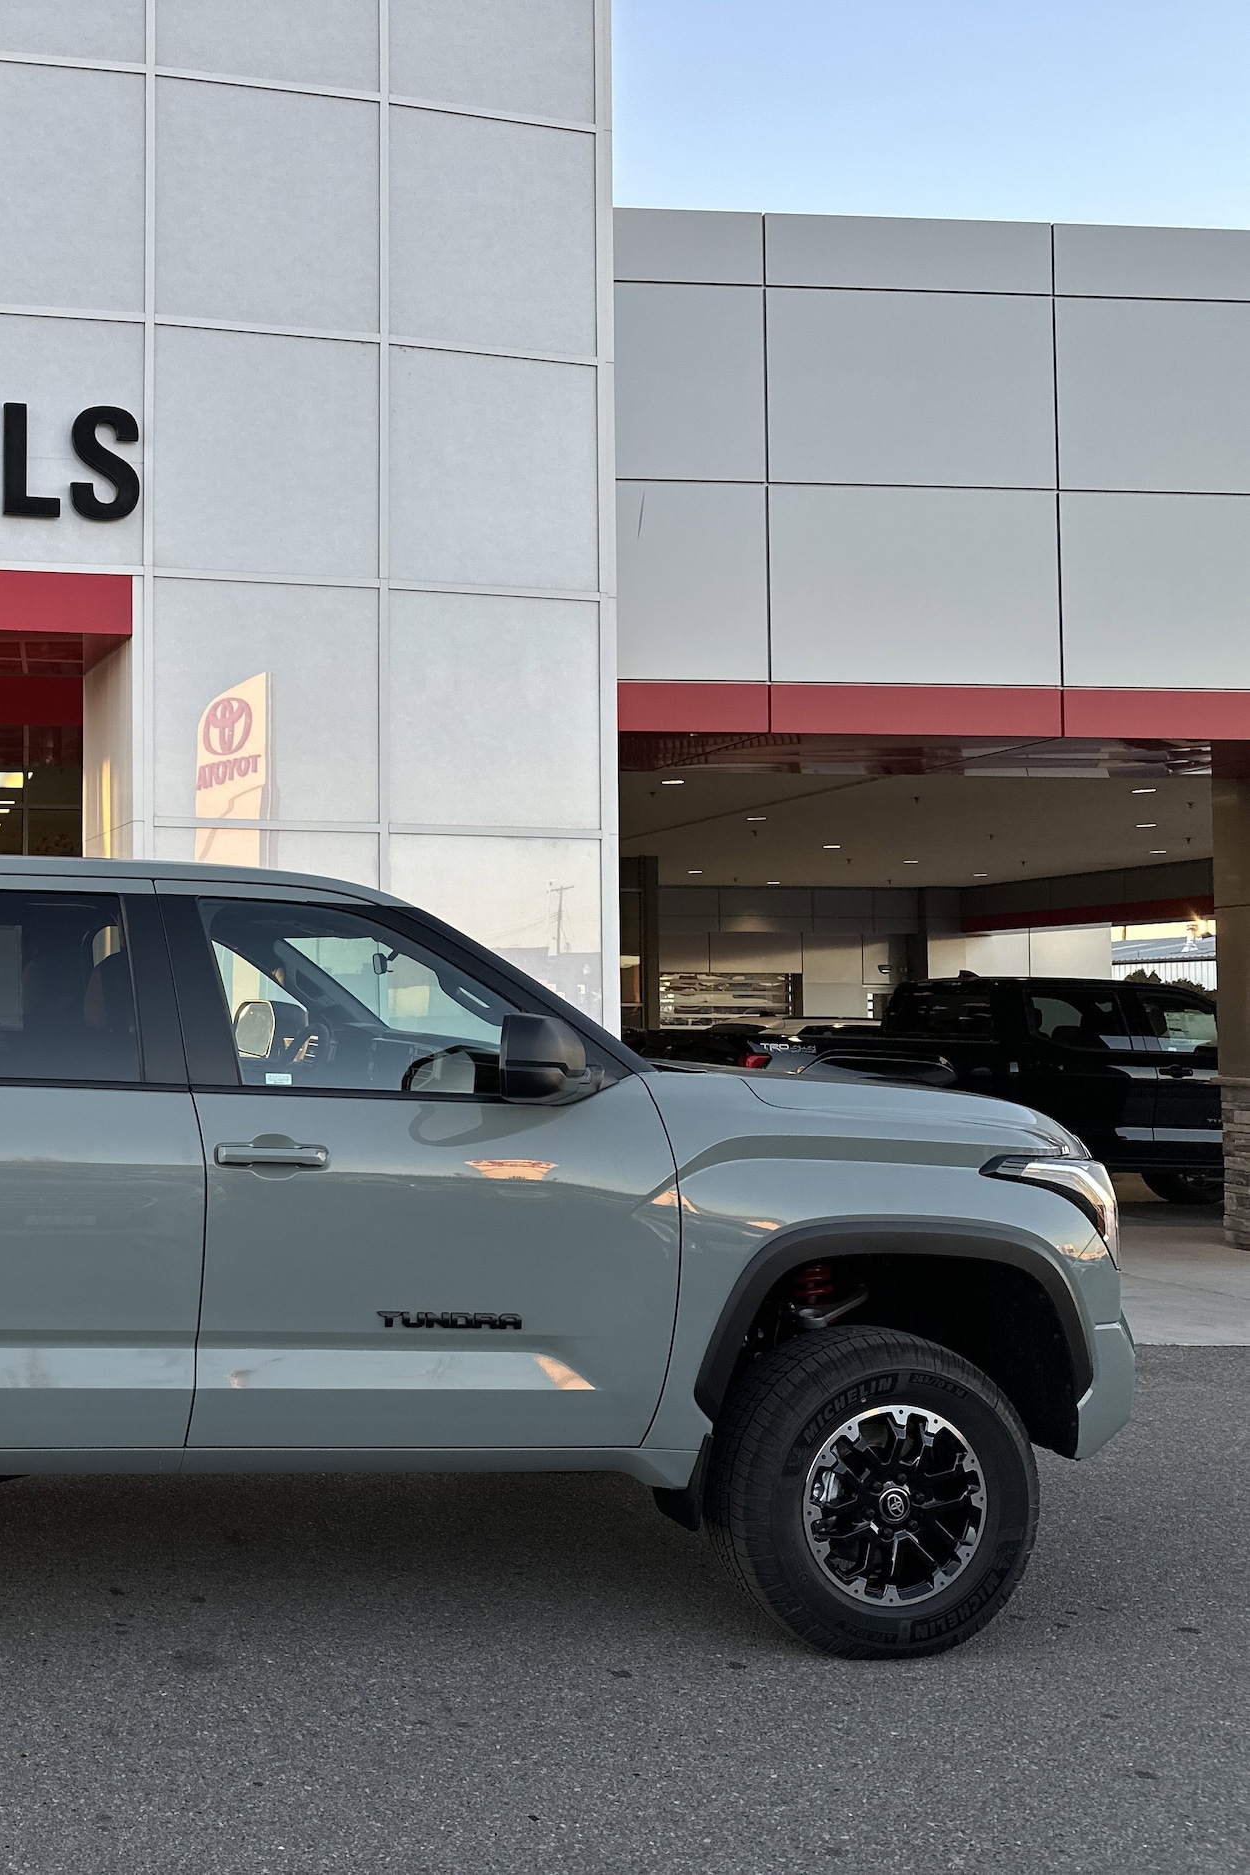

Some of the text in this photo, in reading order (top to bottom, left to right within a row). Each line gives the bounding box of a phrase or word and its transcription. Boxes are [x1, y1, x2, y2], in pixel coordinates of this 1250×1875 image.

[759, 1042, 790, 1053] TRD
[377, 1310, 522, 1330] TUNDRA
[803, 1376, 893, 1441] MICHELIN
[914, 1571, 1001, 1639] MICHELIN
